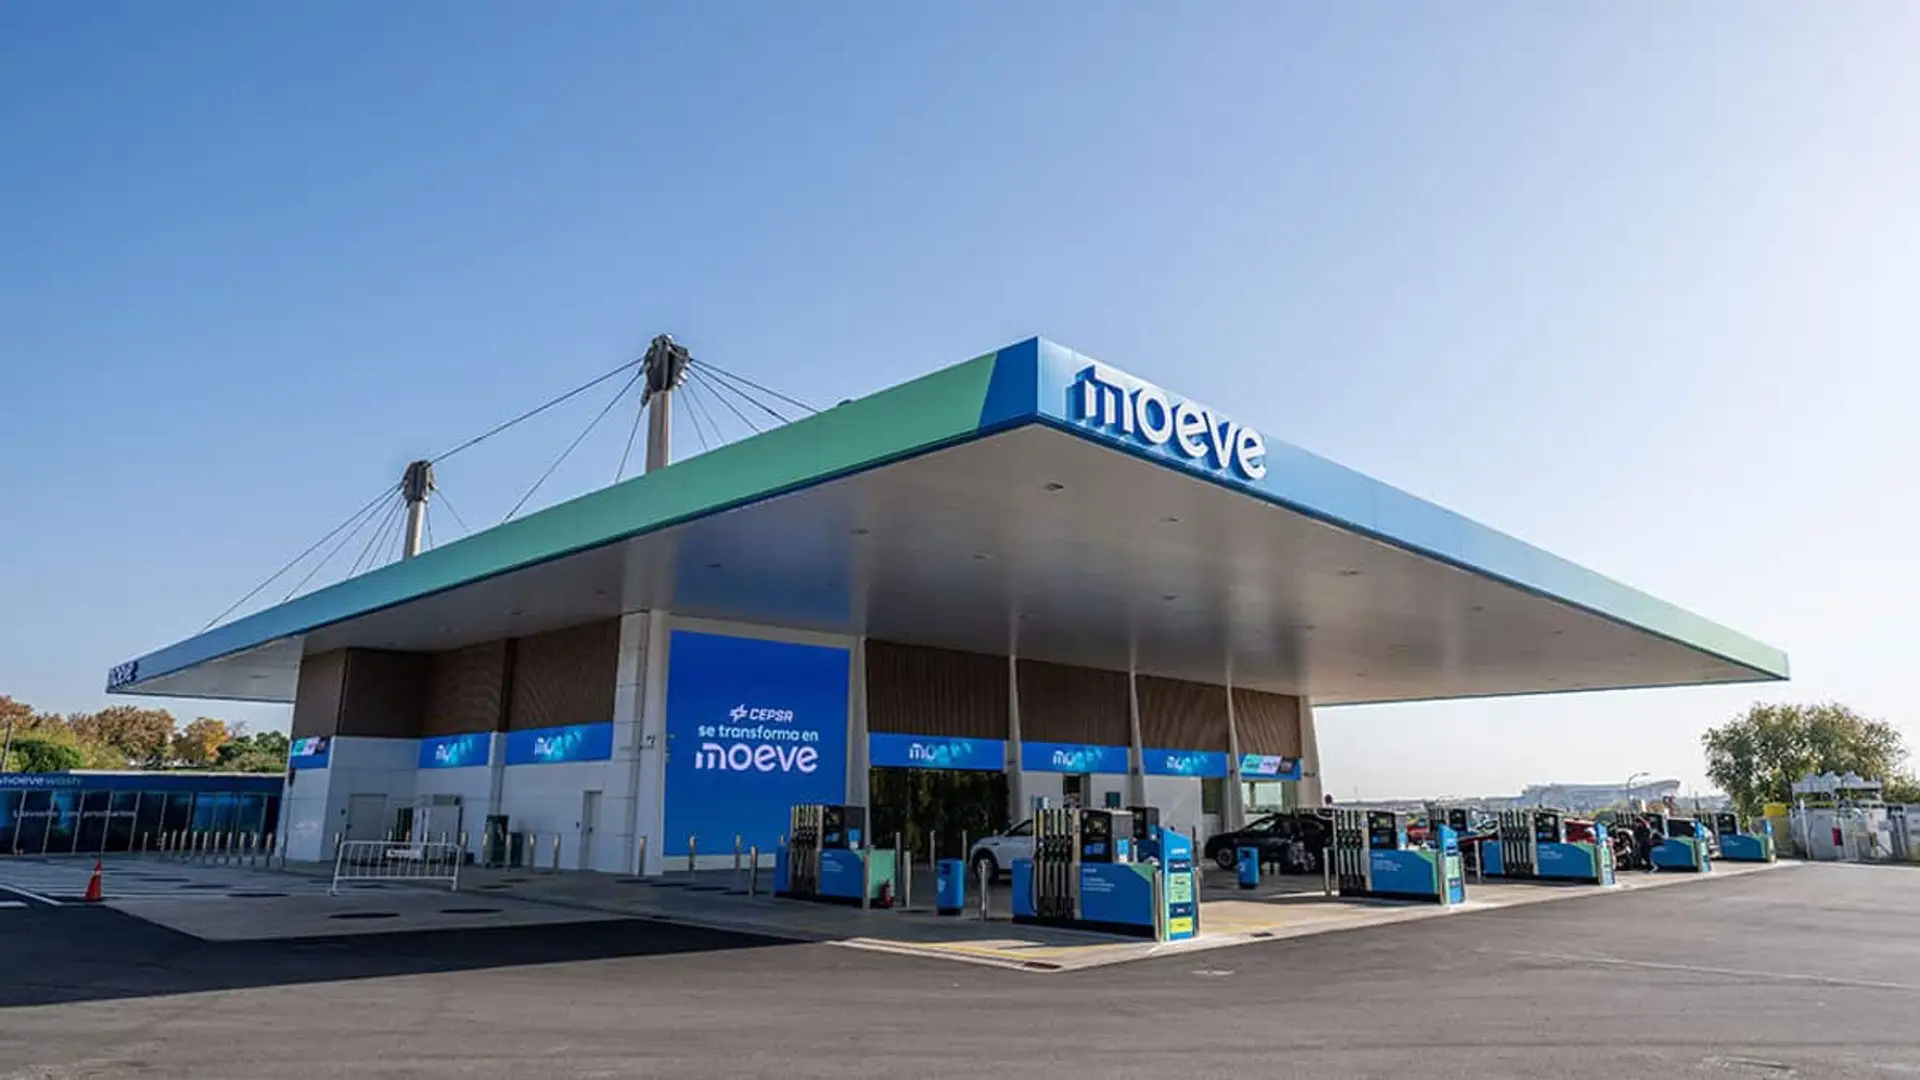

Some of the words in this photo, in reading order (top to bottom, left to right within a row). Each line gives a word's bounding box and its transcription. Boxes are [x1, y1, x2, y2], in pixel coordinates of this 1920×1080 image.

[1084, 364, 1268, 480] moeve
[699, 725, 716, 738] se
[718, 725, 799, 740] transforma
[802, 731, 819, 741] en
[695, 742, 819, 772] moeve
